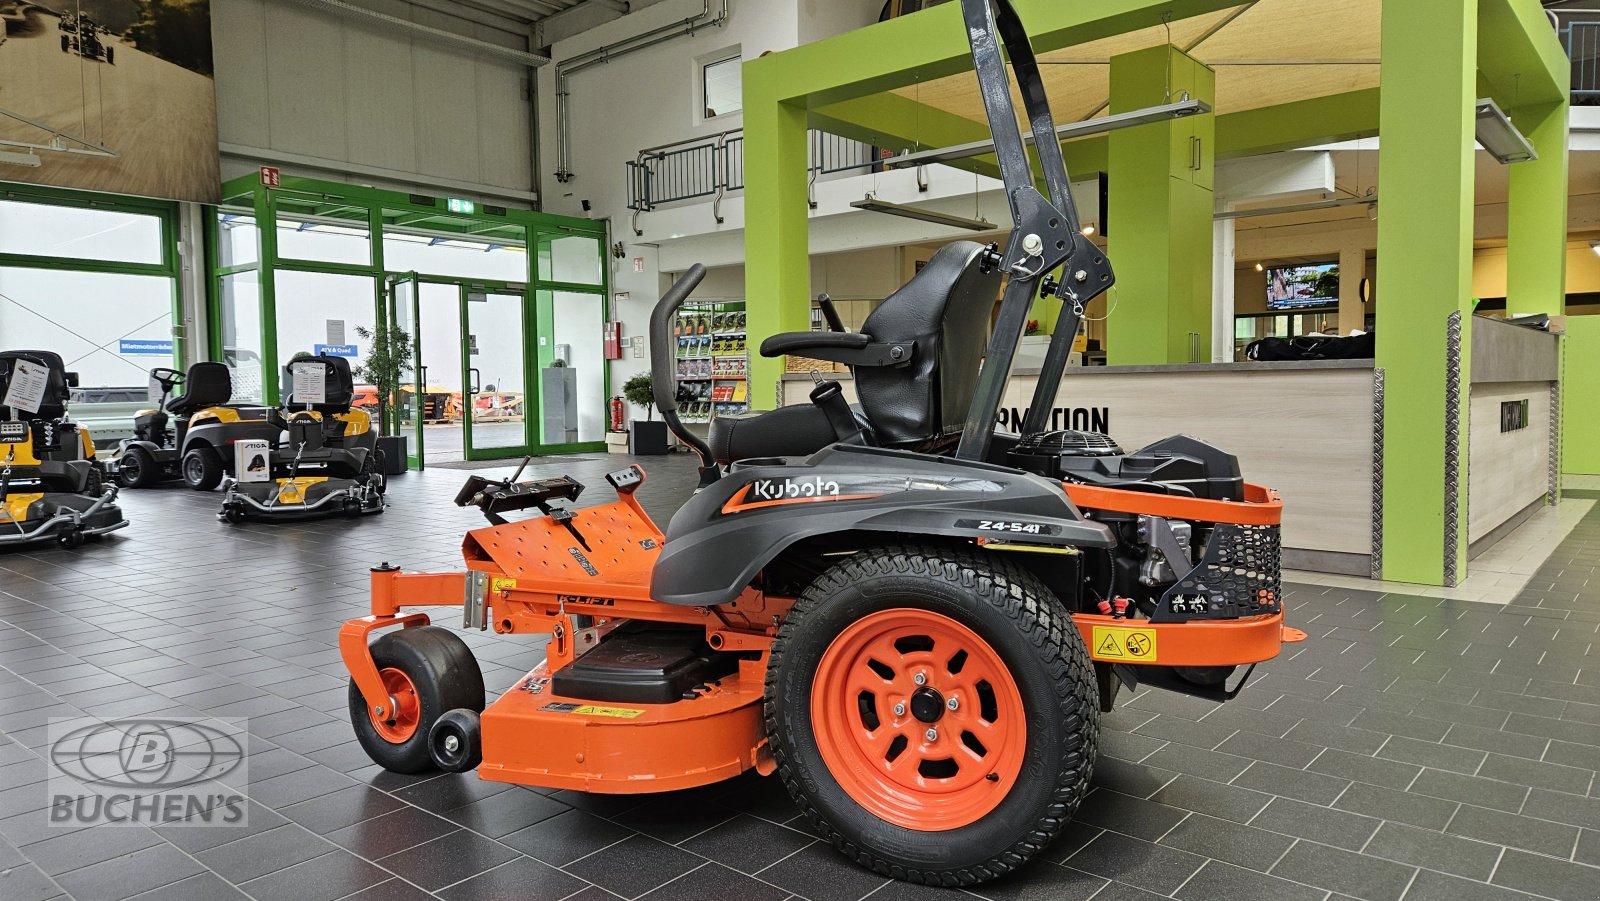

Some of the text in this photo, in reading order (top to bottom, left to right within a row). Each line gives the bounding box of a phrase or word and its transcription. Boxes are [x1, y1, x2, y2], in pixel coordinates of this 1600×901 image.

[999, 407, 1109, 436] RMTION
[754, 476, 840, 500] Kubota
[978, 520, 1040, 534] Z4-541
[558, 595, 613, 605] K-LIFT
